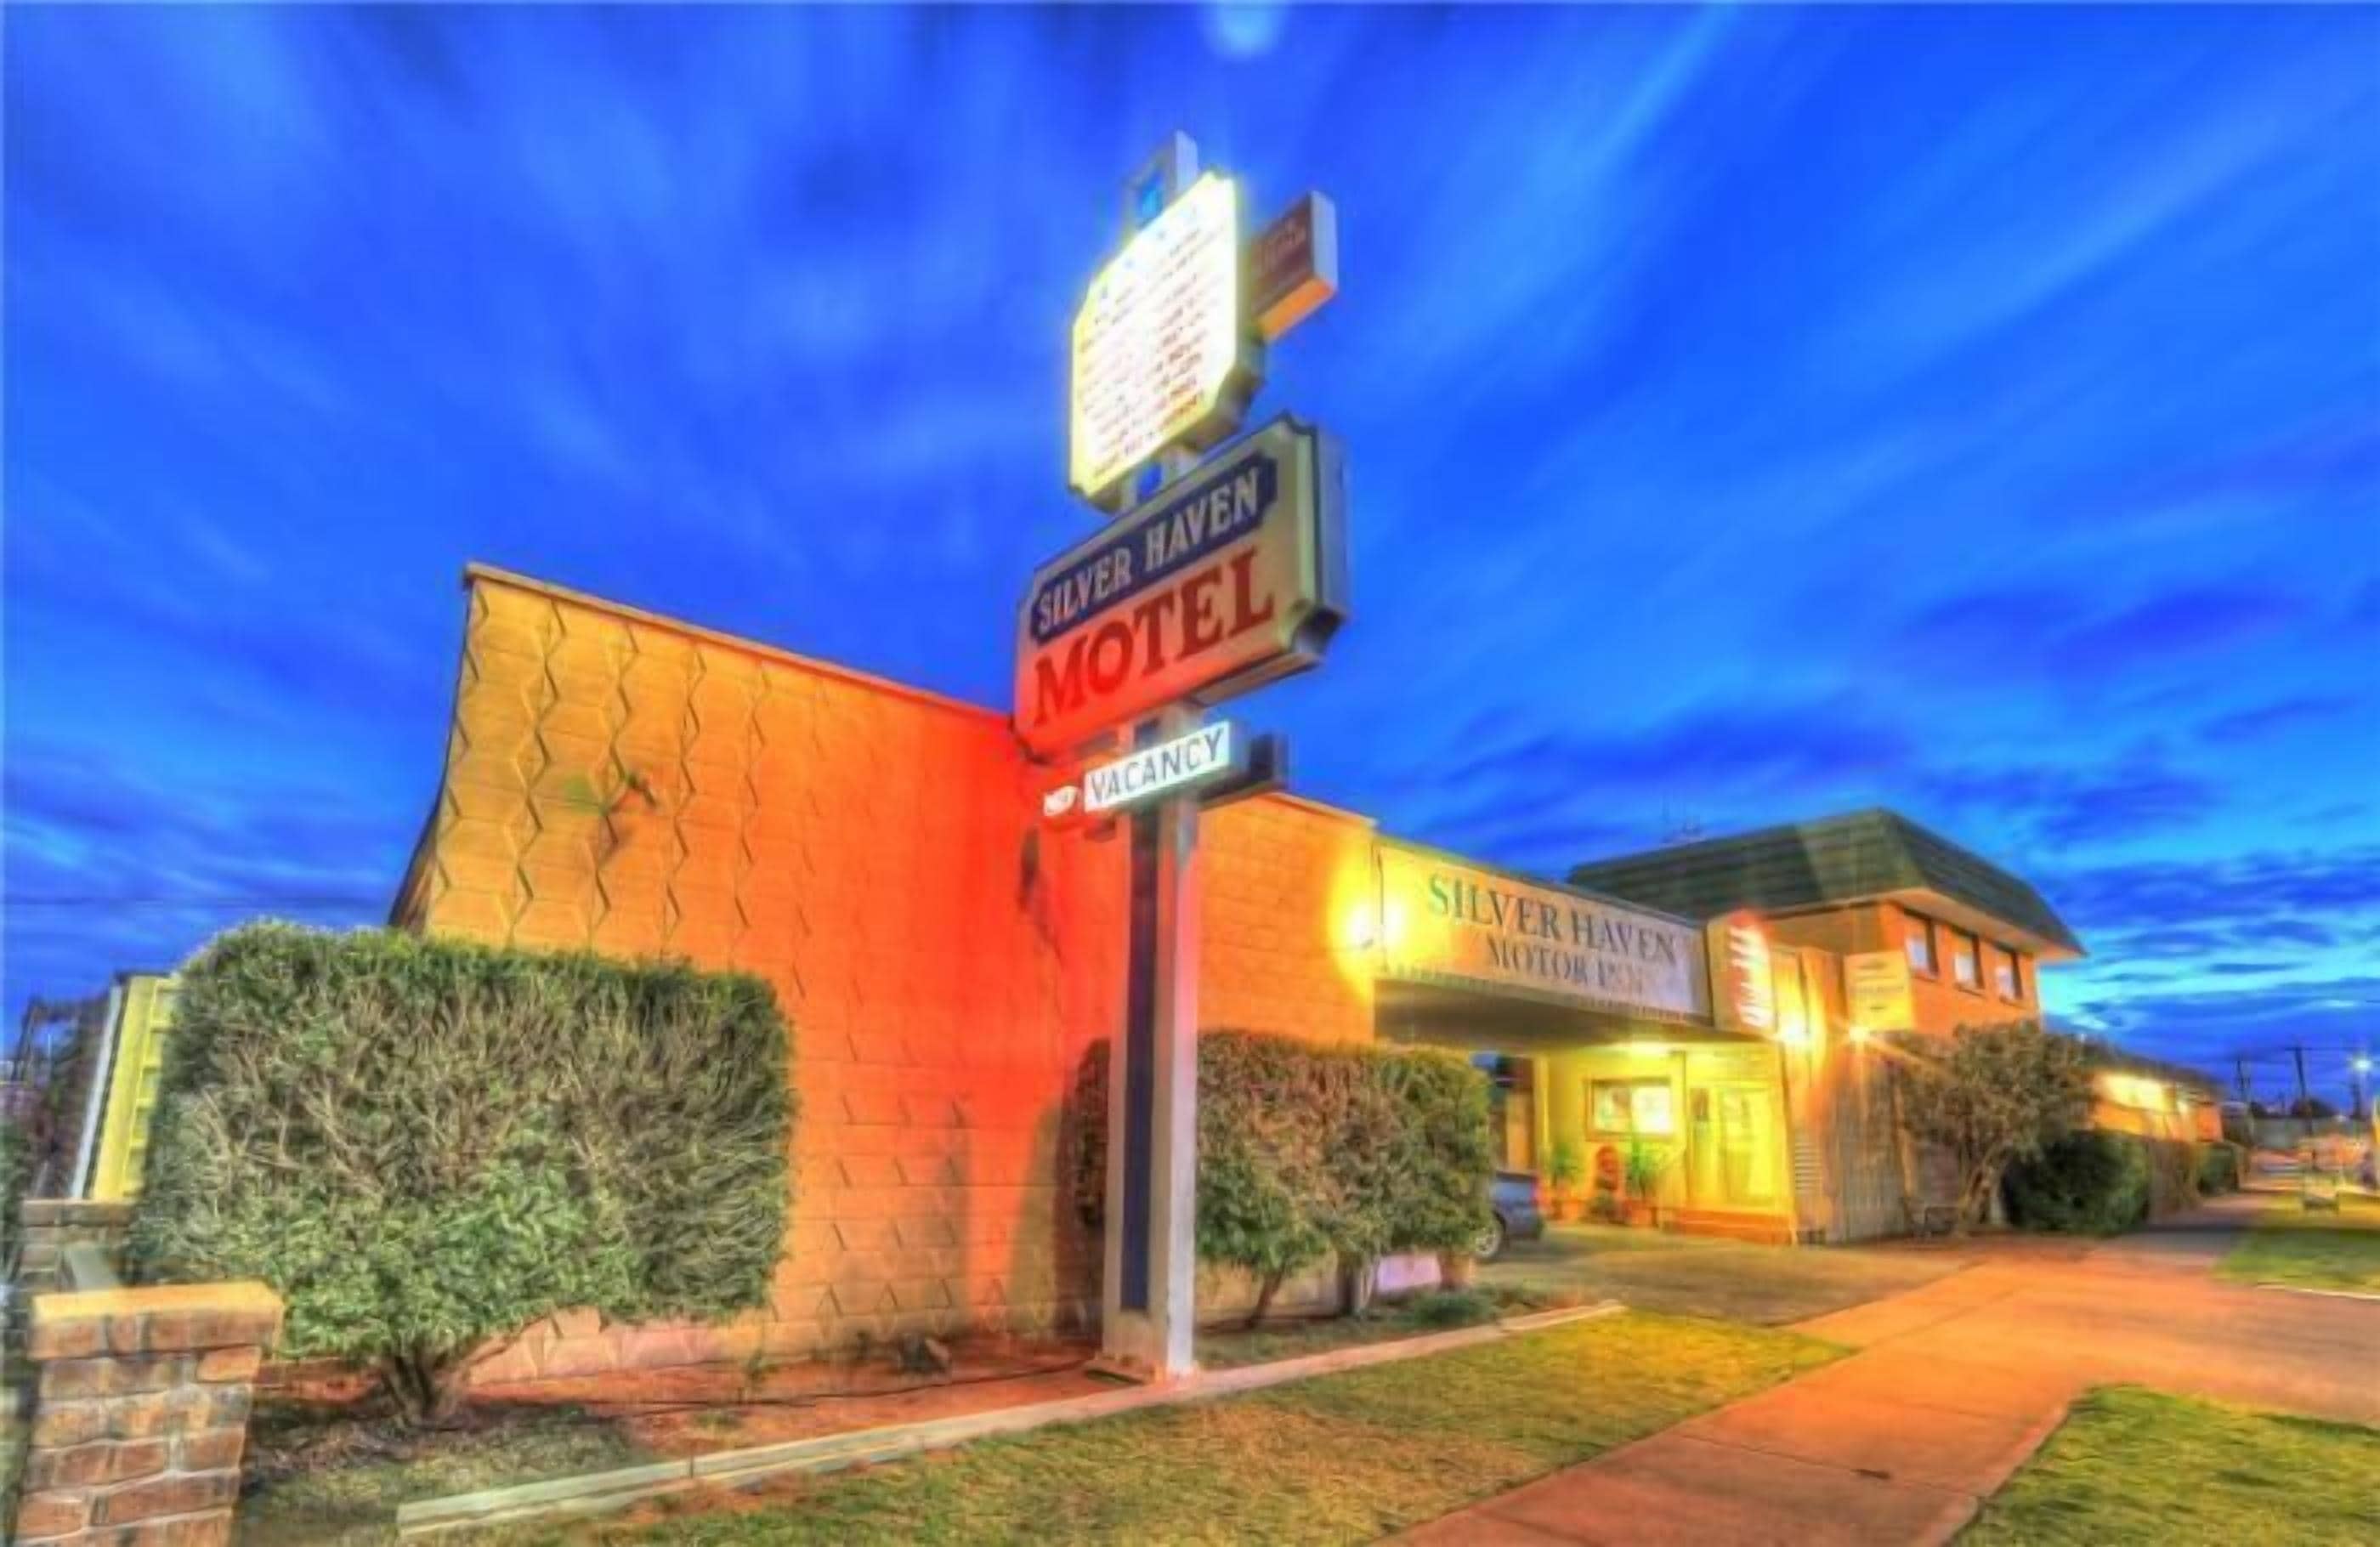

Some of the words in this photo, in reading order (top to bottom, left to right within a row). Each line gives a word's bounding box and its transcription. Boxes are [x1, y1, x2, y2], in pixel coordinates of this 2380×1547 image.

[1038, 547, 1132, 636] SILVER
[1145, 467, 1260, 573] HAVEN
[1033, 546, 1273, 728] MOTEL
[1091, 728, 1224, 804] VACANCY
[1429, 873, 1562, 940] SILVER
[1571, 910, 1677, 966] HAVEN
[1487, 938, 1590, 986] MOTOR
